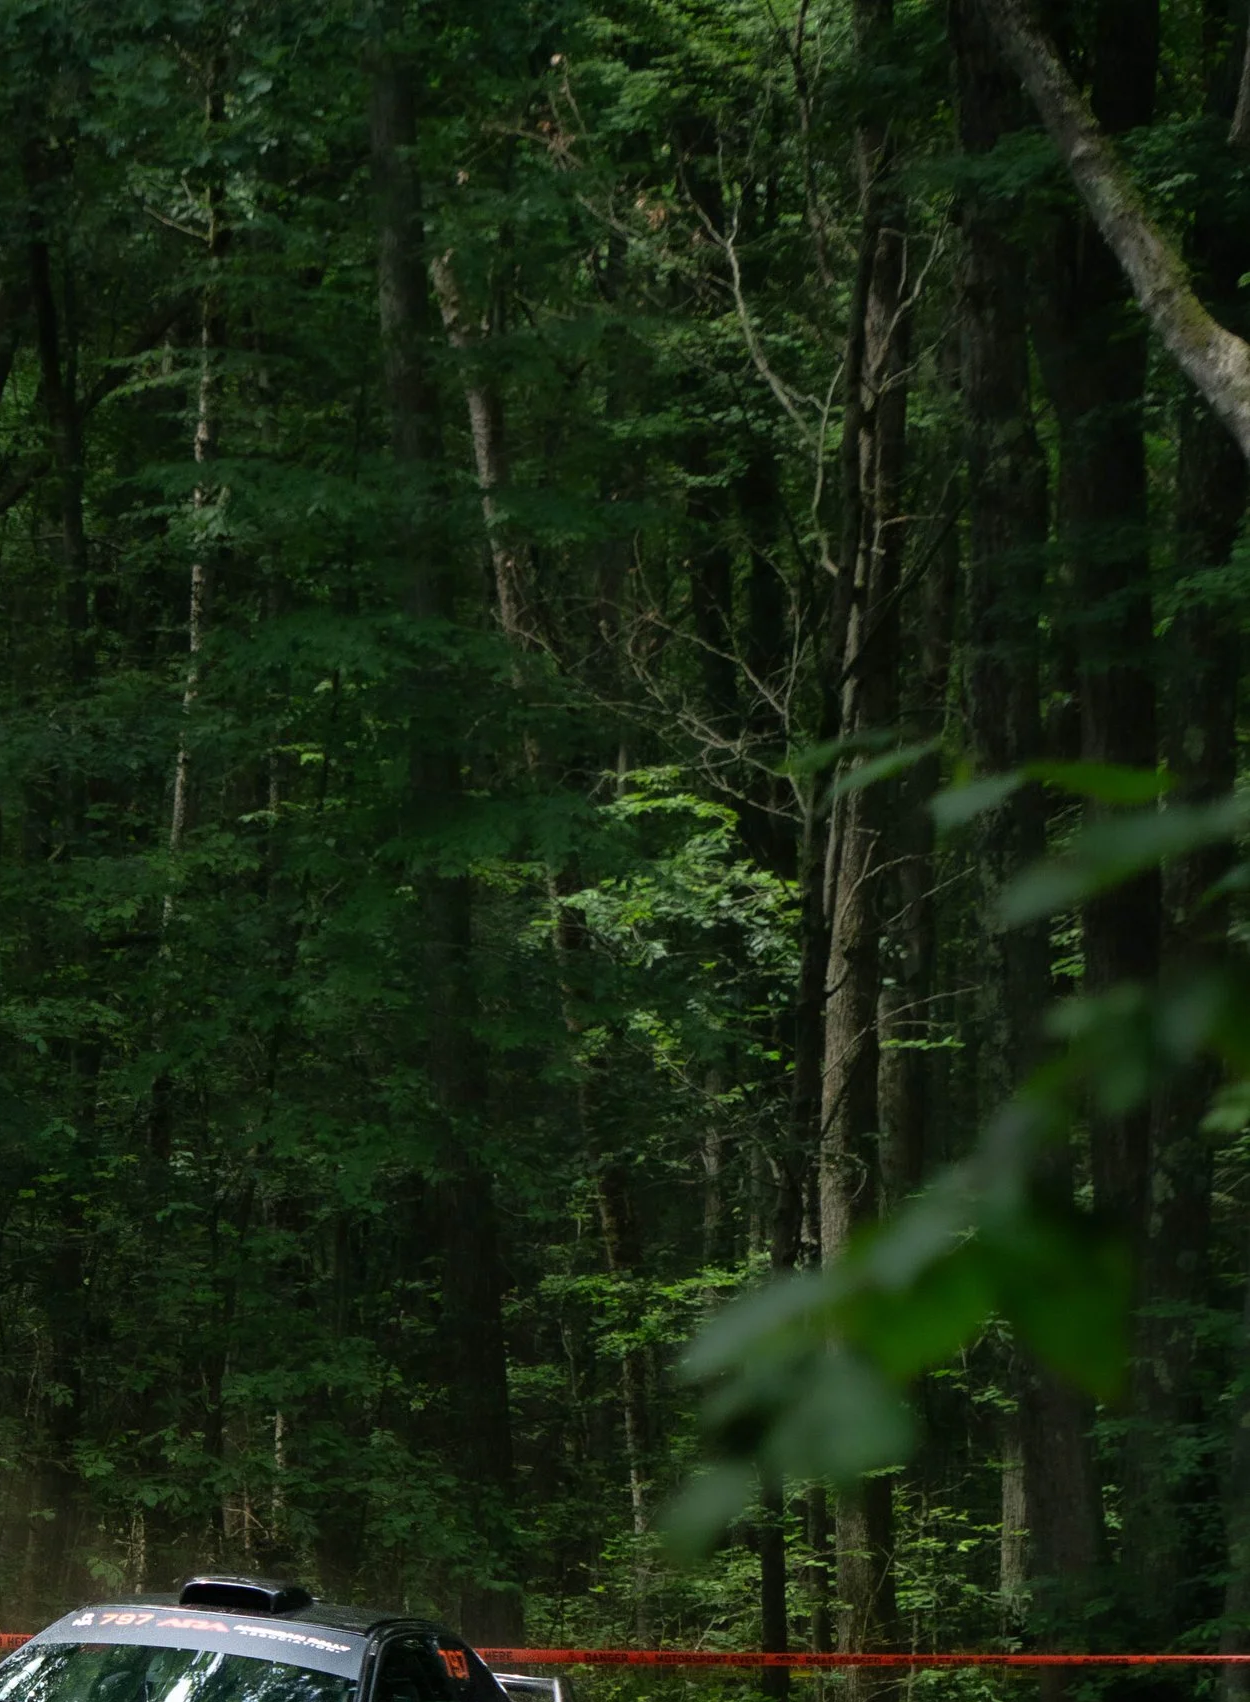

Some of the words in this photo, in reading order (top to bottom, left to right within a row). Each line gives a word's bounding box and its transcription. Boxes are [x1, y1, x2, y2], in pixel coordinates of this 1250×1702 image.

[99, 1612, 155, 1625] 797
[7, 1637, 32, 1649] HER
[483, 1650, 512, 1661] HERE
[584, 1652, 628, 1662] DANGER
[655, 1653, 727, 1664] MOTORSPORT
[730, 1655, 765, 1664] EVENT
[438, 1648, 470, 1680] 797
